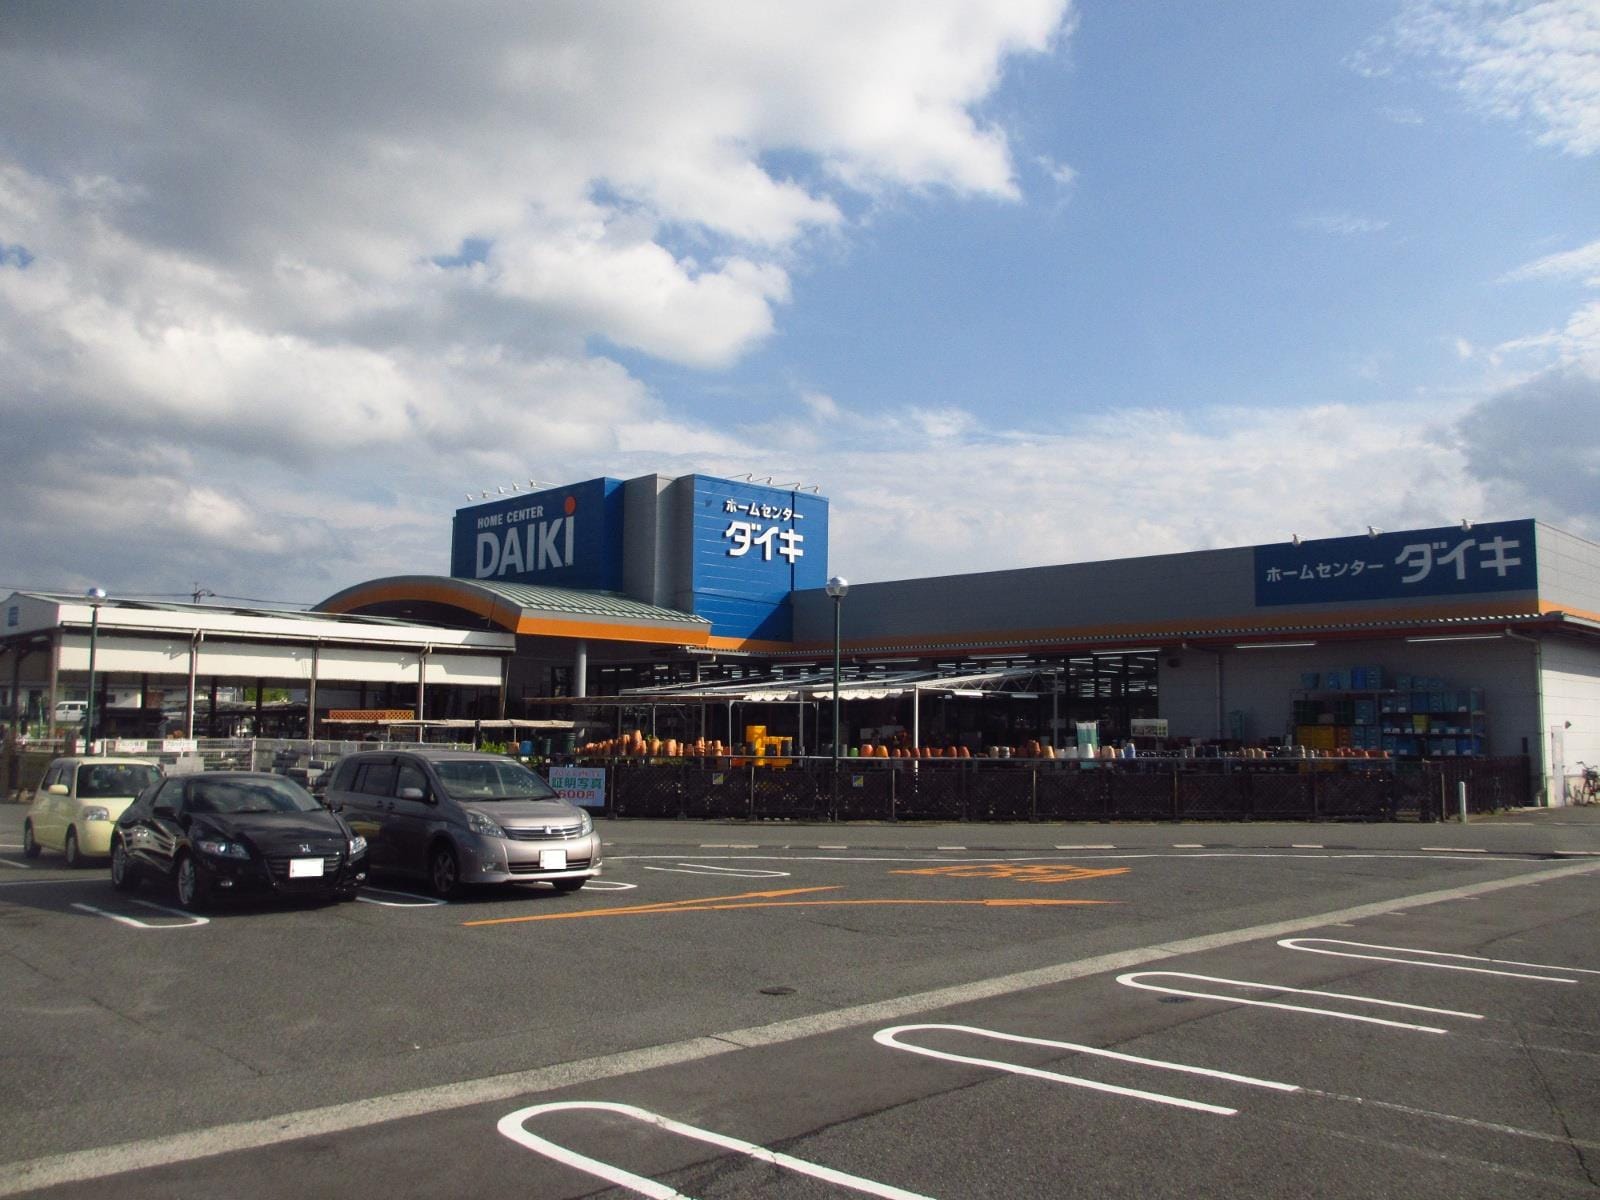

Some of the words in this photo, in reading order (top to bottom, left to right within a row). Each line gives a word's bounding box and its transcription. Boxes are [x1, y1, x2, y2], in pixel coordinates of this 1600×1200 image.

[477, 514, 503, 529] HOME
[507, 505, 544, 523] CENTER
[726, 499, 804, 521] ホームセンター
[725, 520, 804, 563] ダイキ
[1266, 559, 1384, 582] ホームセンター
[1395, 536, 1521, 583] ダイキ
